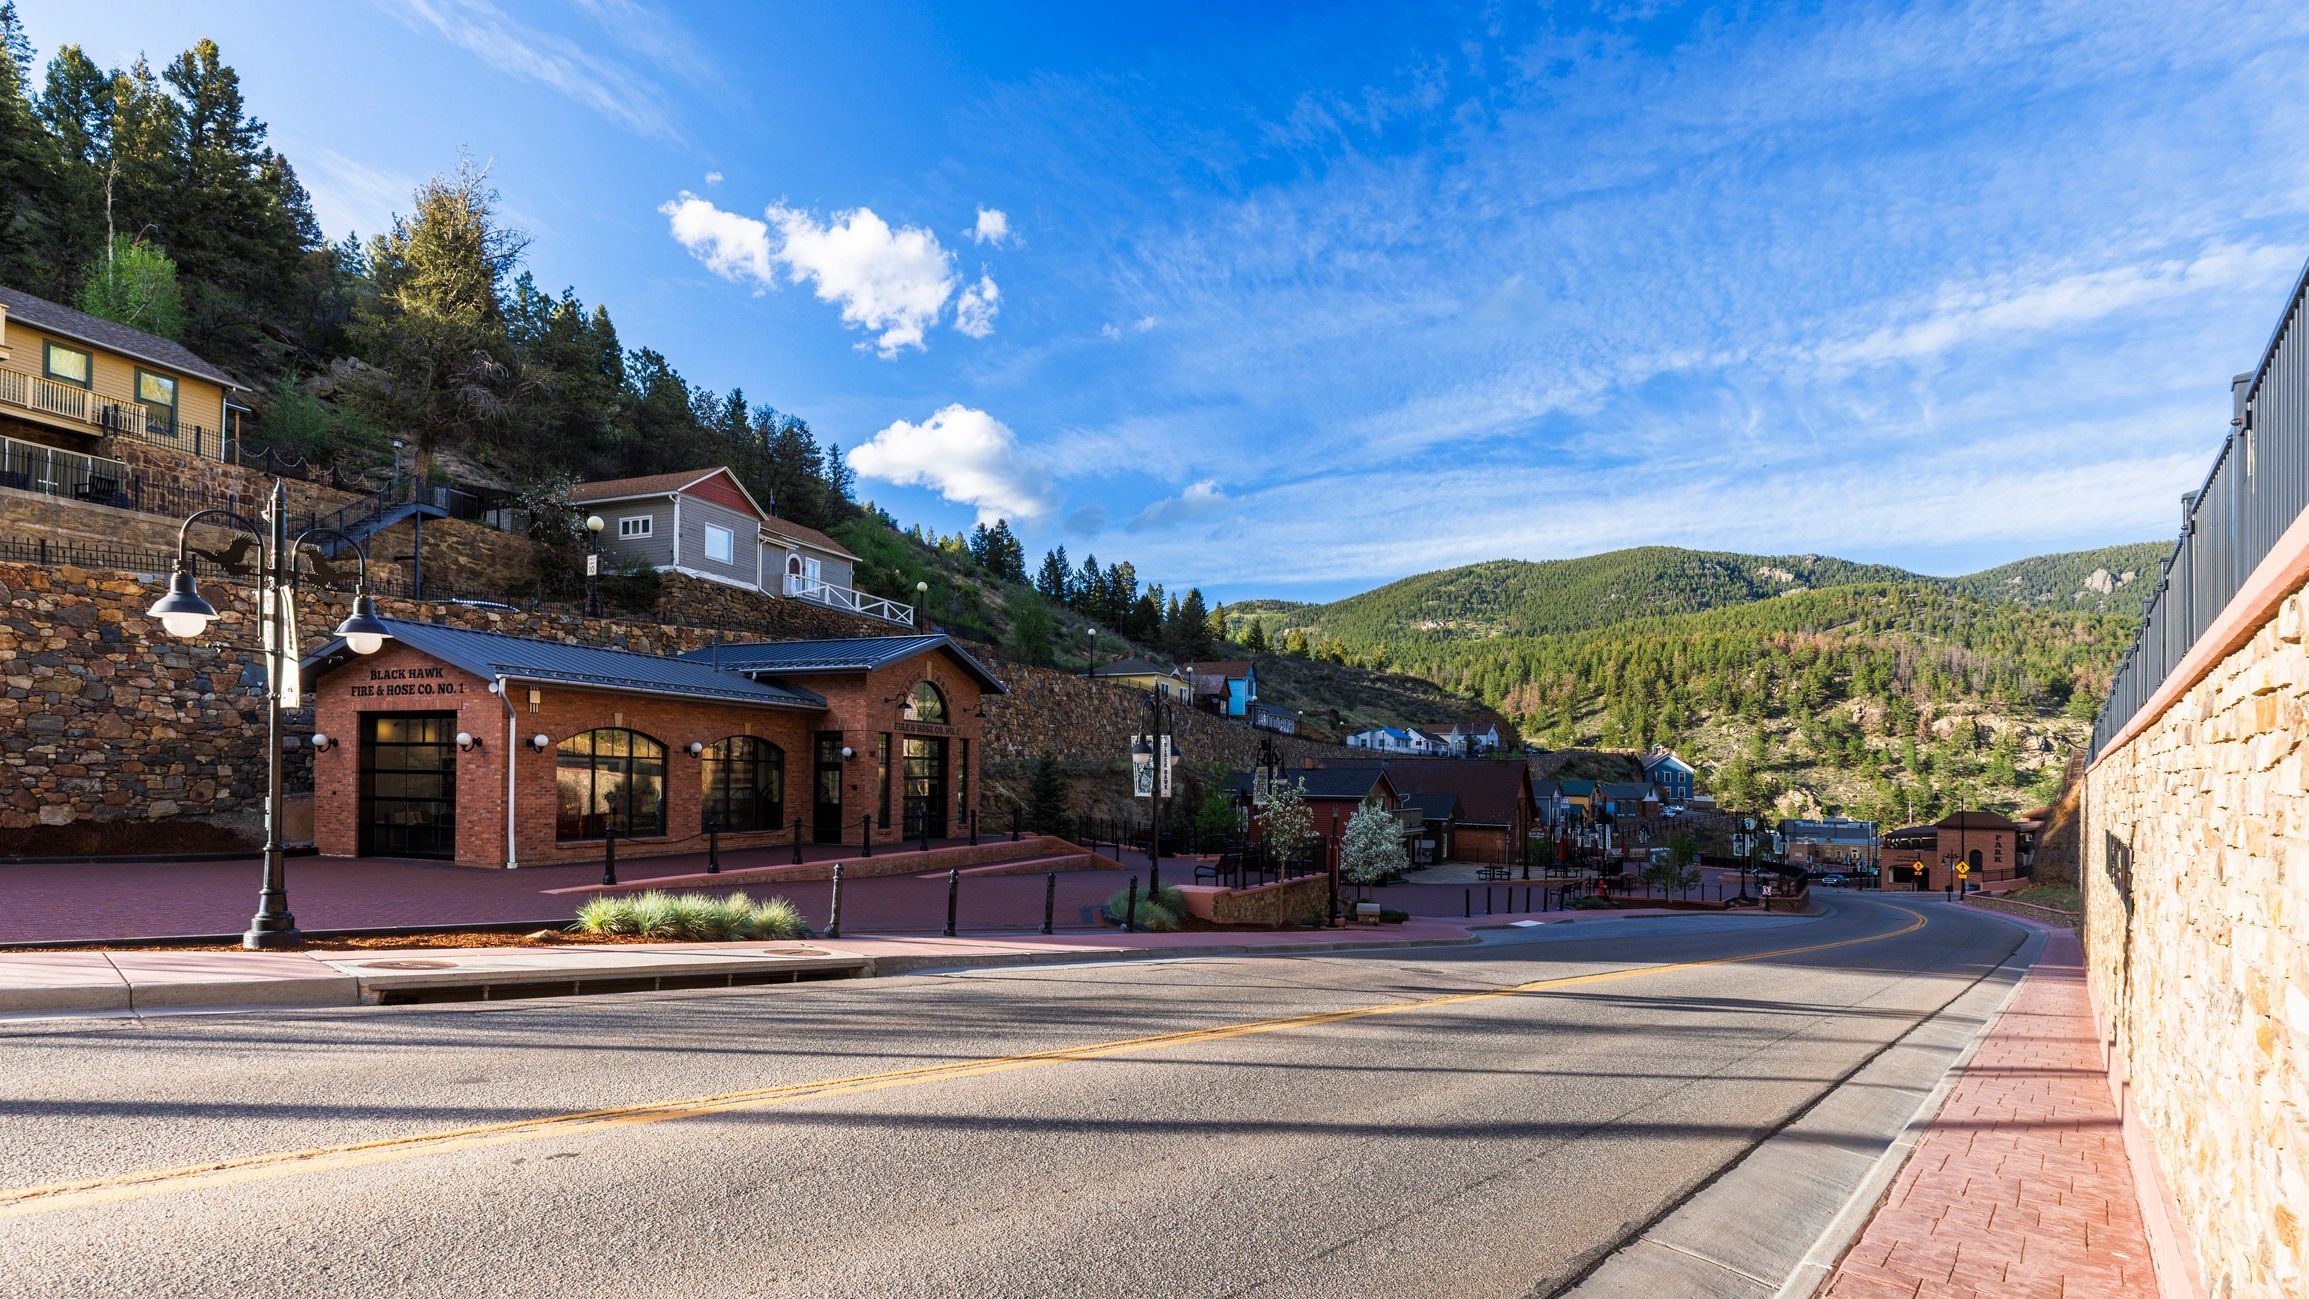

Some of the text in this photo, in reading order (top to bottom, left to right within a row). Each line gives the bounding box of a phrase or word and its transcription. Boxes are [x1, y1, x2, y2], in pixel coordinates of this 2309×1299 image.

[370, 668, 444, 680] BLACK HAWK
[351, 682, 465, 697] FIRE & HOSE CO. NO. 1
[895, 722, 910, 731] FIRE
[917, 724, 934, 734] HOSE
[1994, 834, 2002, 863] PARK
